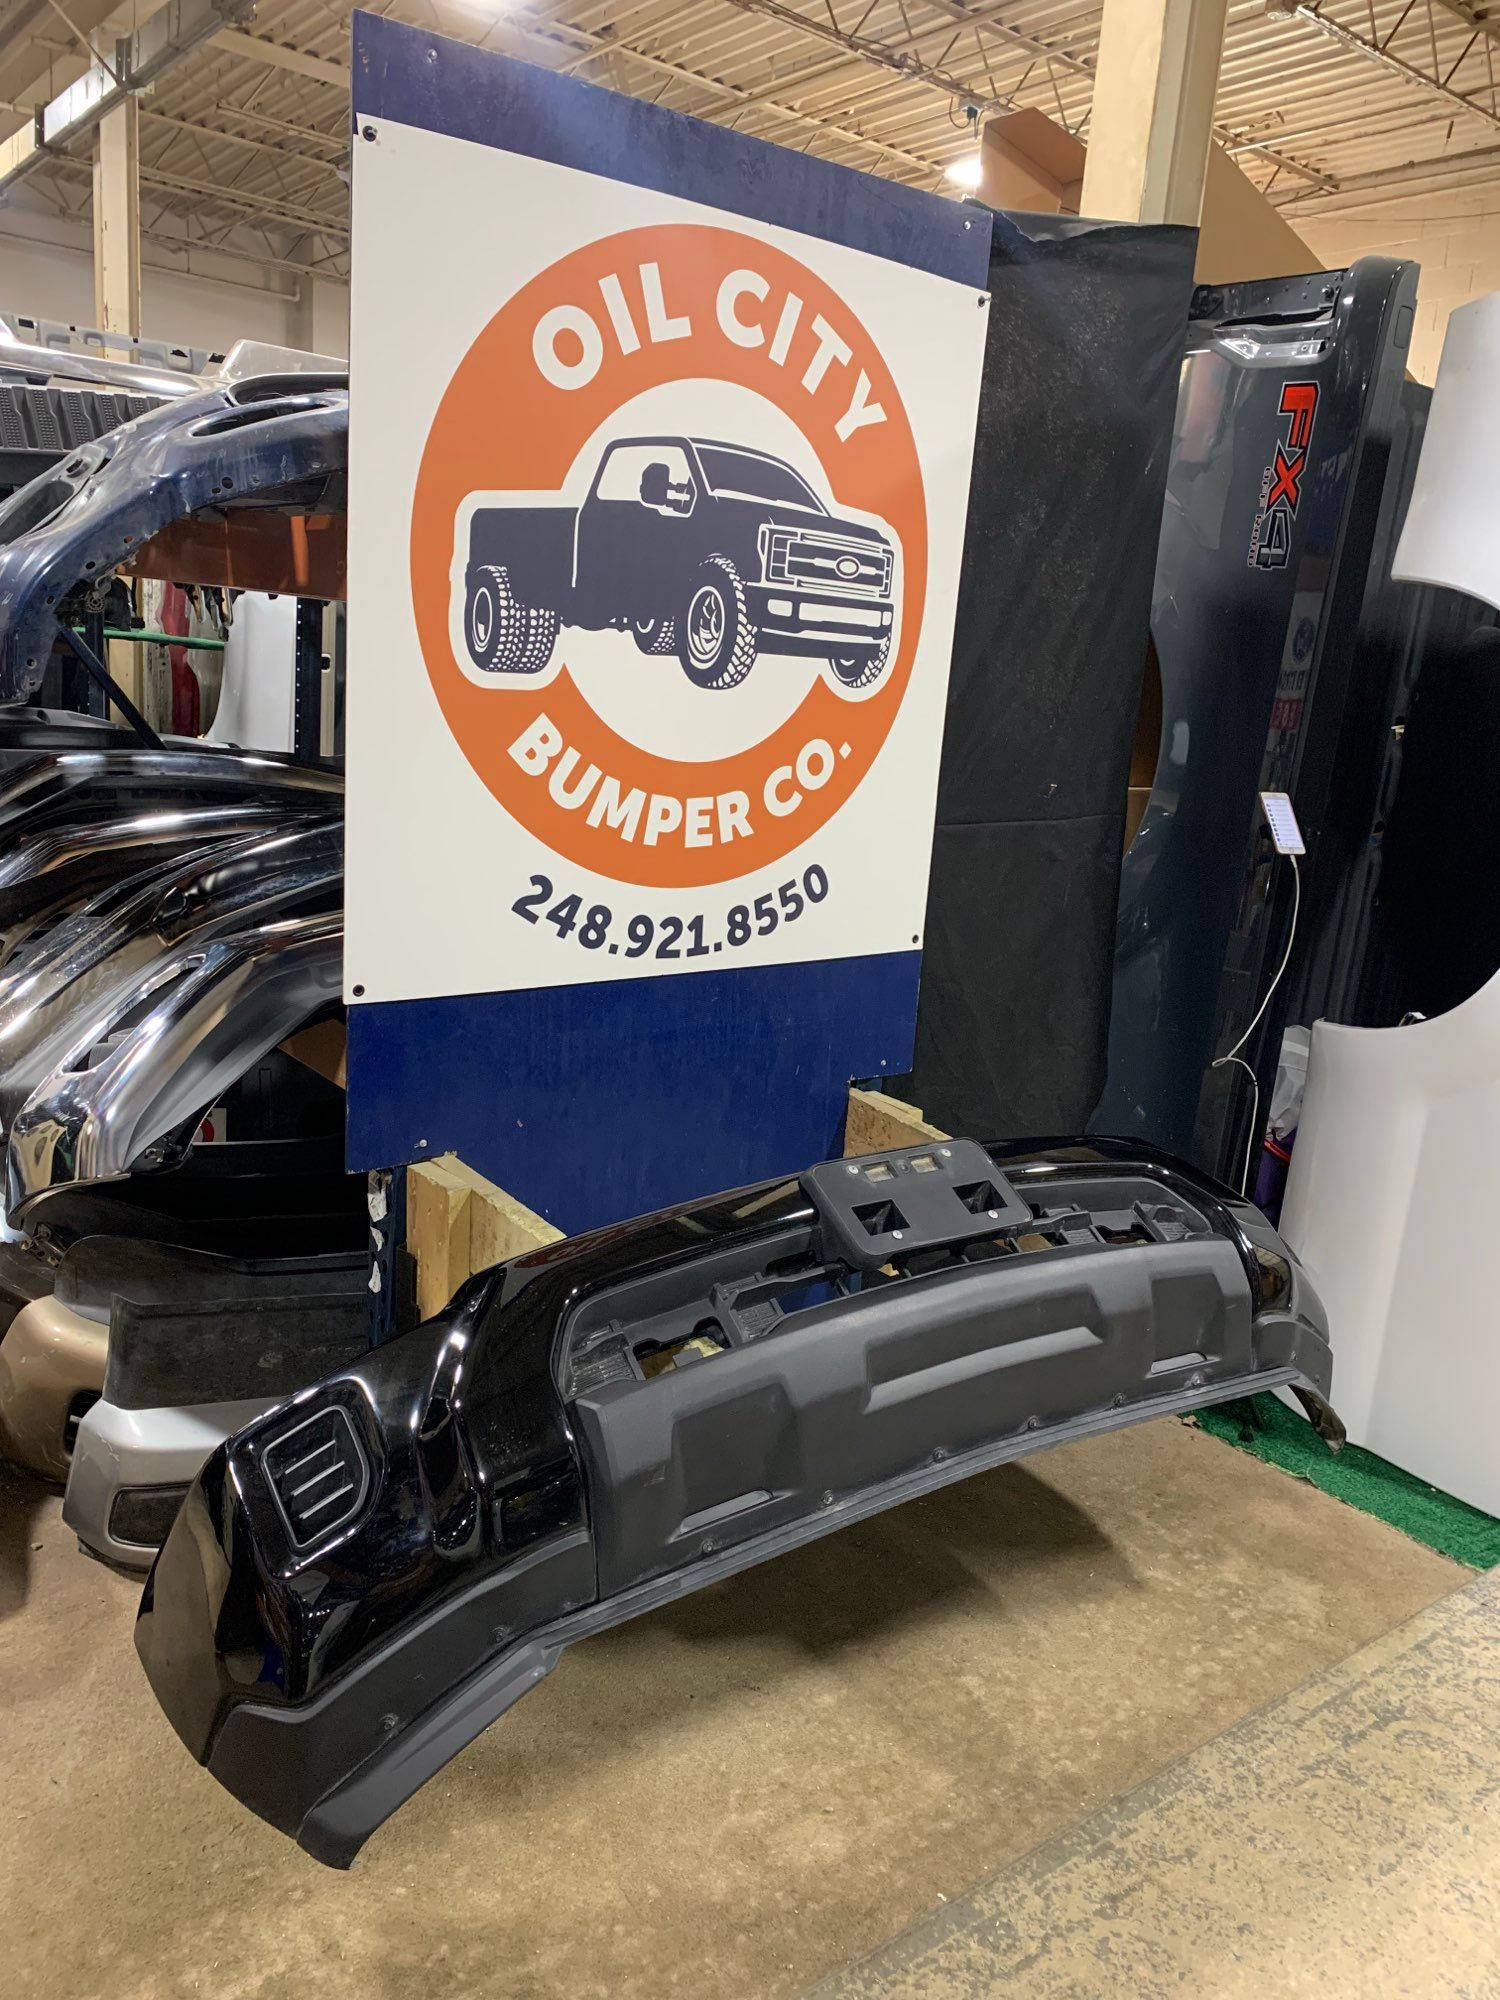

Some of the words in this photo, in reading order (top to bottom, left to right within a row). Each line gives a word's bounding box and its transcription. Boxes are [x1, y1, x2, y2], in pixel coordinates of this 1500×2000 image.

[532, 262, 692, 390] OIL
[716, 269, 888, 443] CITY
[1256, 380, 1321, 570] FX4
[506, 712, 755, 848] BUMPER
[763, 738, 852, 817] CO.
[511, 864, 829, 959] 248.921.8550
